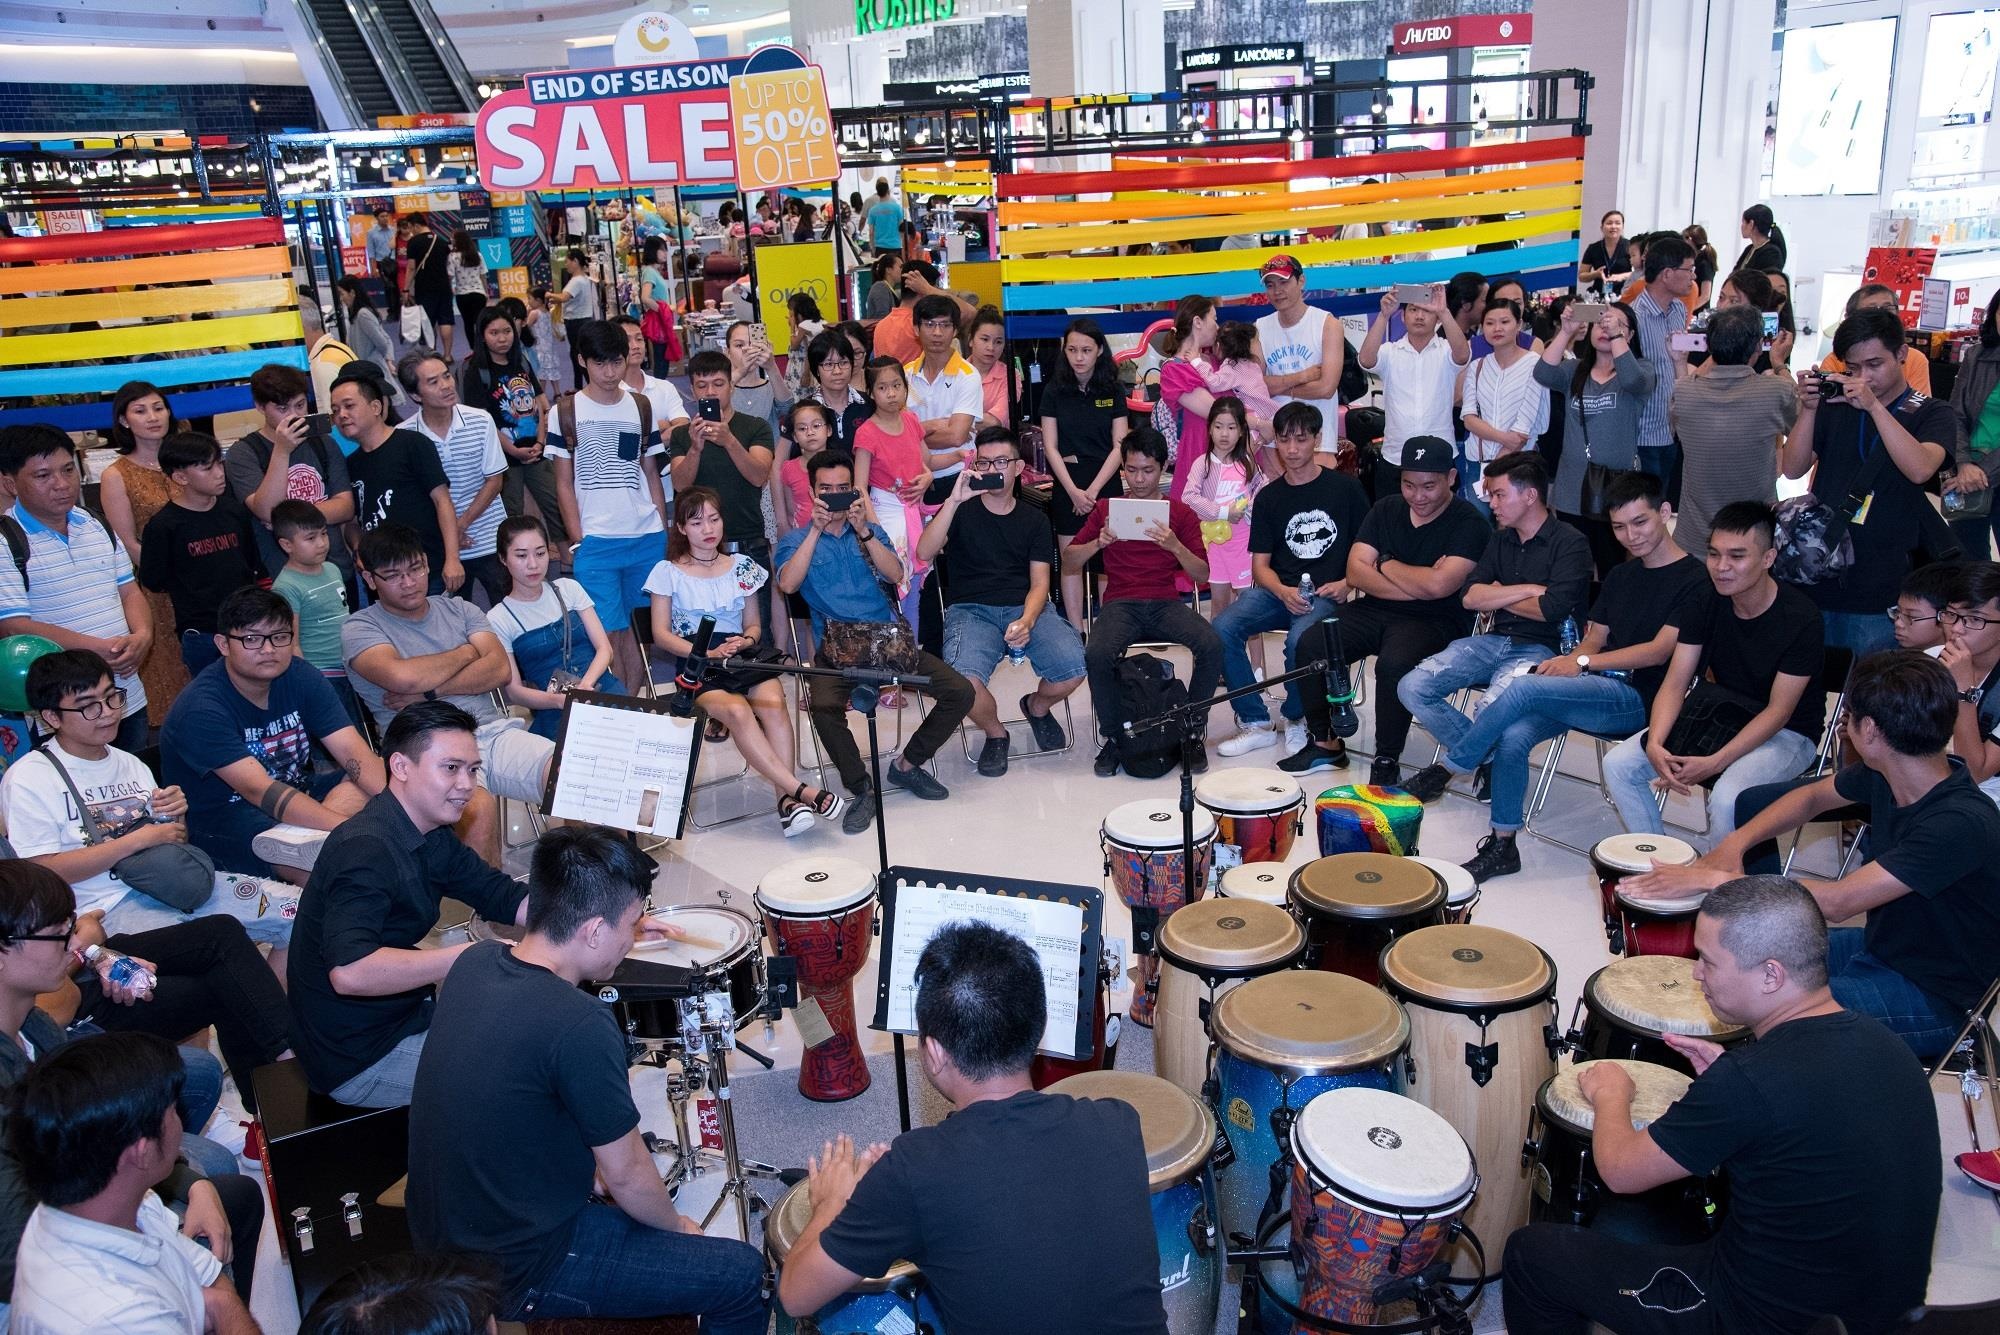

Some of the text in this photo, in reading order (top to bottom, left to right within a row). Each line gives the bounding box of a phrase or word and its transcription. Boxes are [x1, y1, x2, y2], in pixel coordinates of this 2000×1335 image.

[1401, 26, 1452, 45] SHISEIDO
[1234, 48, 1286, 62] LANCÔME
[531, 63, 730, 101] END OF SEASON
[745, 79, 811, 110] UP TO
[420, 118, 445, 127] SHOP
[741, 106, 827, 146] 50%
[485, 101, 735, 187] SALE
[754, 140, 824, 185] OFF
[400, 199, 427, 210] SALE
[467, 199, 485, 207] SALE
[51, 210, 77, 220] SALE
[508, 208, 525, 217] SALE
[465, 223, 488, 231] PARTY
[510, 217, 525, 225] THIS
[511, 225, 525, 234] WAY
[343, 256, 365, 265] ARTY
[500, 271, 525, 284] BIG
[501, 283, 527, 294] SALE
[1894, 289, 1922, 312] LE
[1267, 346, 1288, 367] ROCK
[1296, 343, 1314, 361] ROLL
[188, 537, 217, 557] CRUSH
[215, 534, 230, 551] ON
[63, 788, 95, 821] LS
[1160, 1252, 1191, 1288] arl
